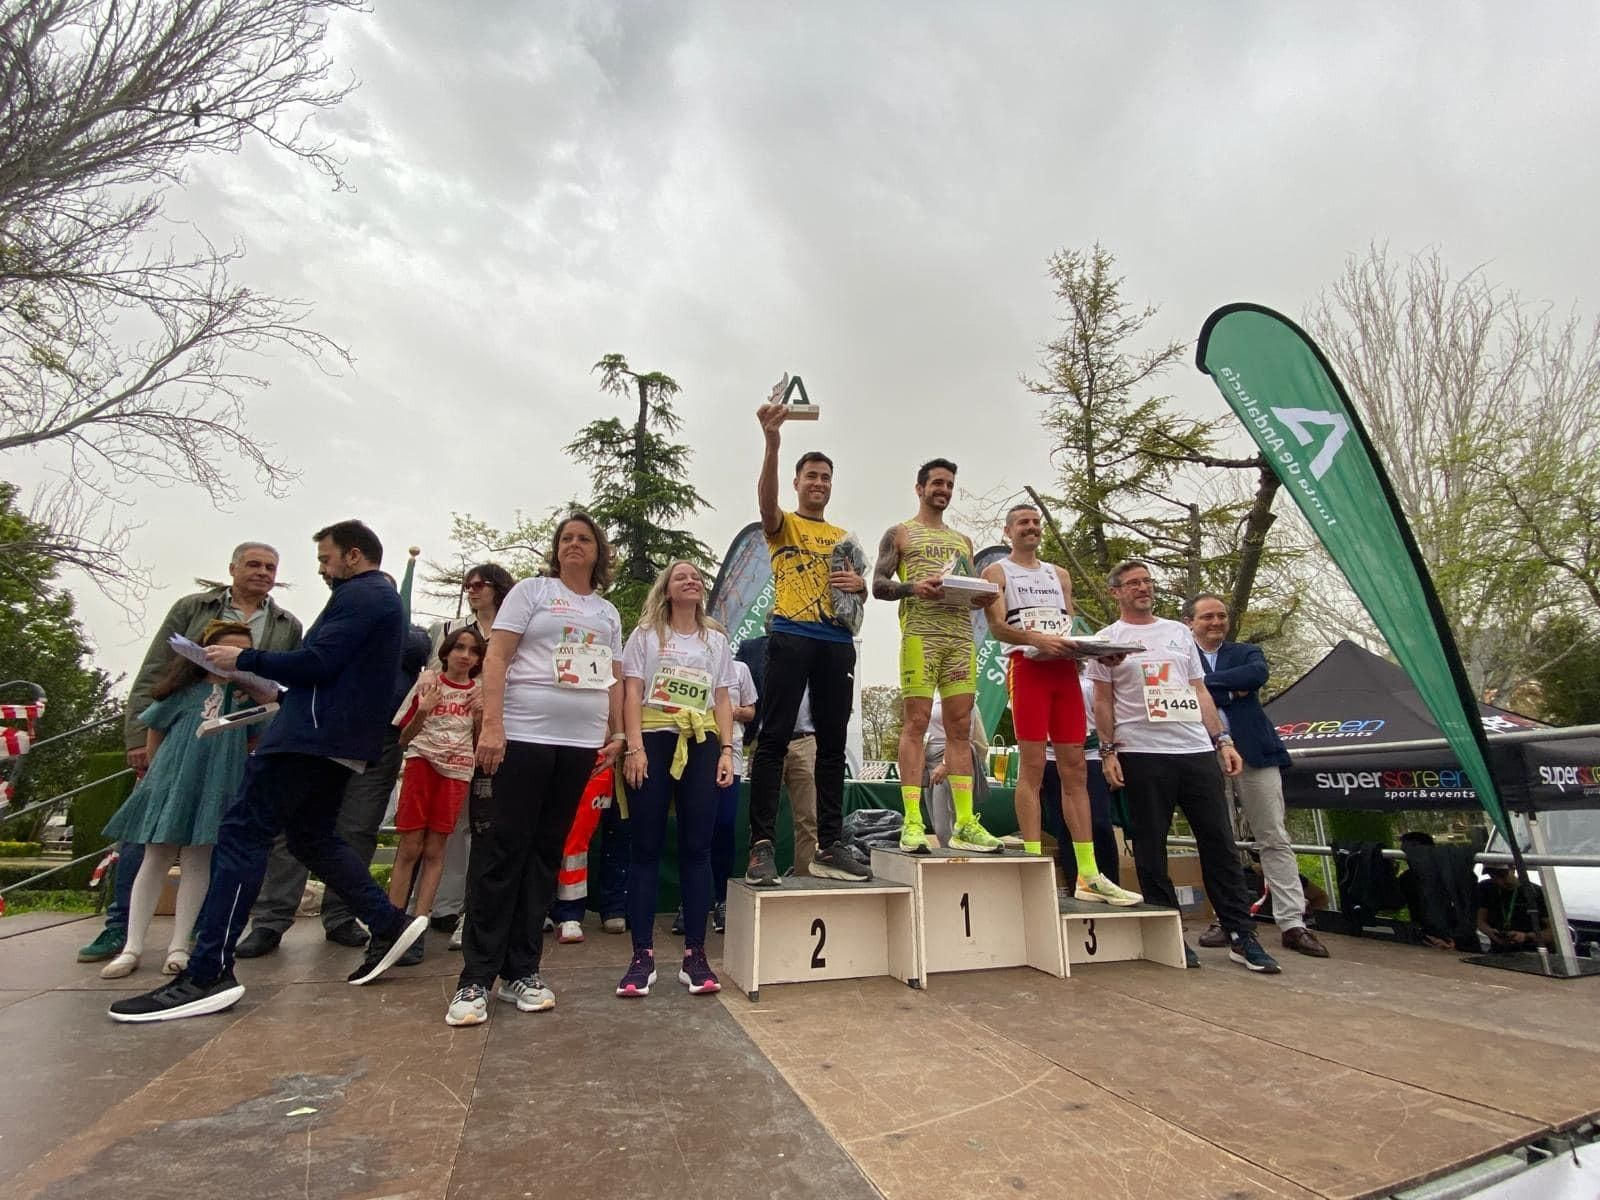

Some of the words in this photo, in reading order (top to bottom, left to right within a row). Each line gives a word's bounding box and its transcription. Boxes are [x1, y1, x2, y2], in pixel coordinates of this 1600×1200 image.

[590, 662, 598, 674] 1
[987, 655, 1010, 685] SA
[668, 681, 708, 701] 5501
[1160, 699, 1198, 710] 1448
[1274, 719, 1385, 735] screen
[1280, 731, 1373, 741] ort&events
[959, 893, 972, 937] 1
[810, 918, 827, 968] 2
[1083, 918, 1098, 956] 3
